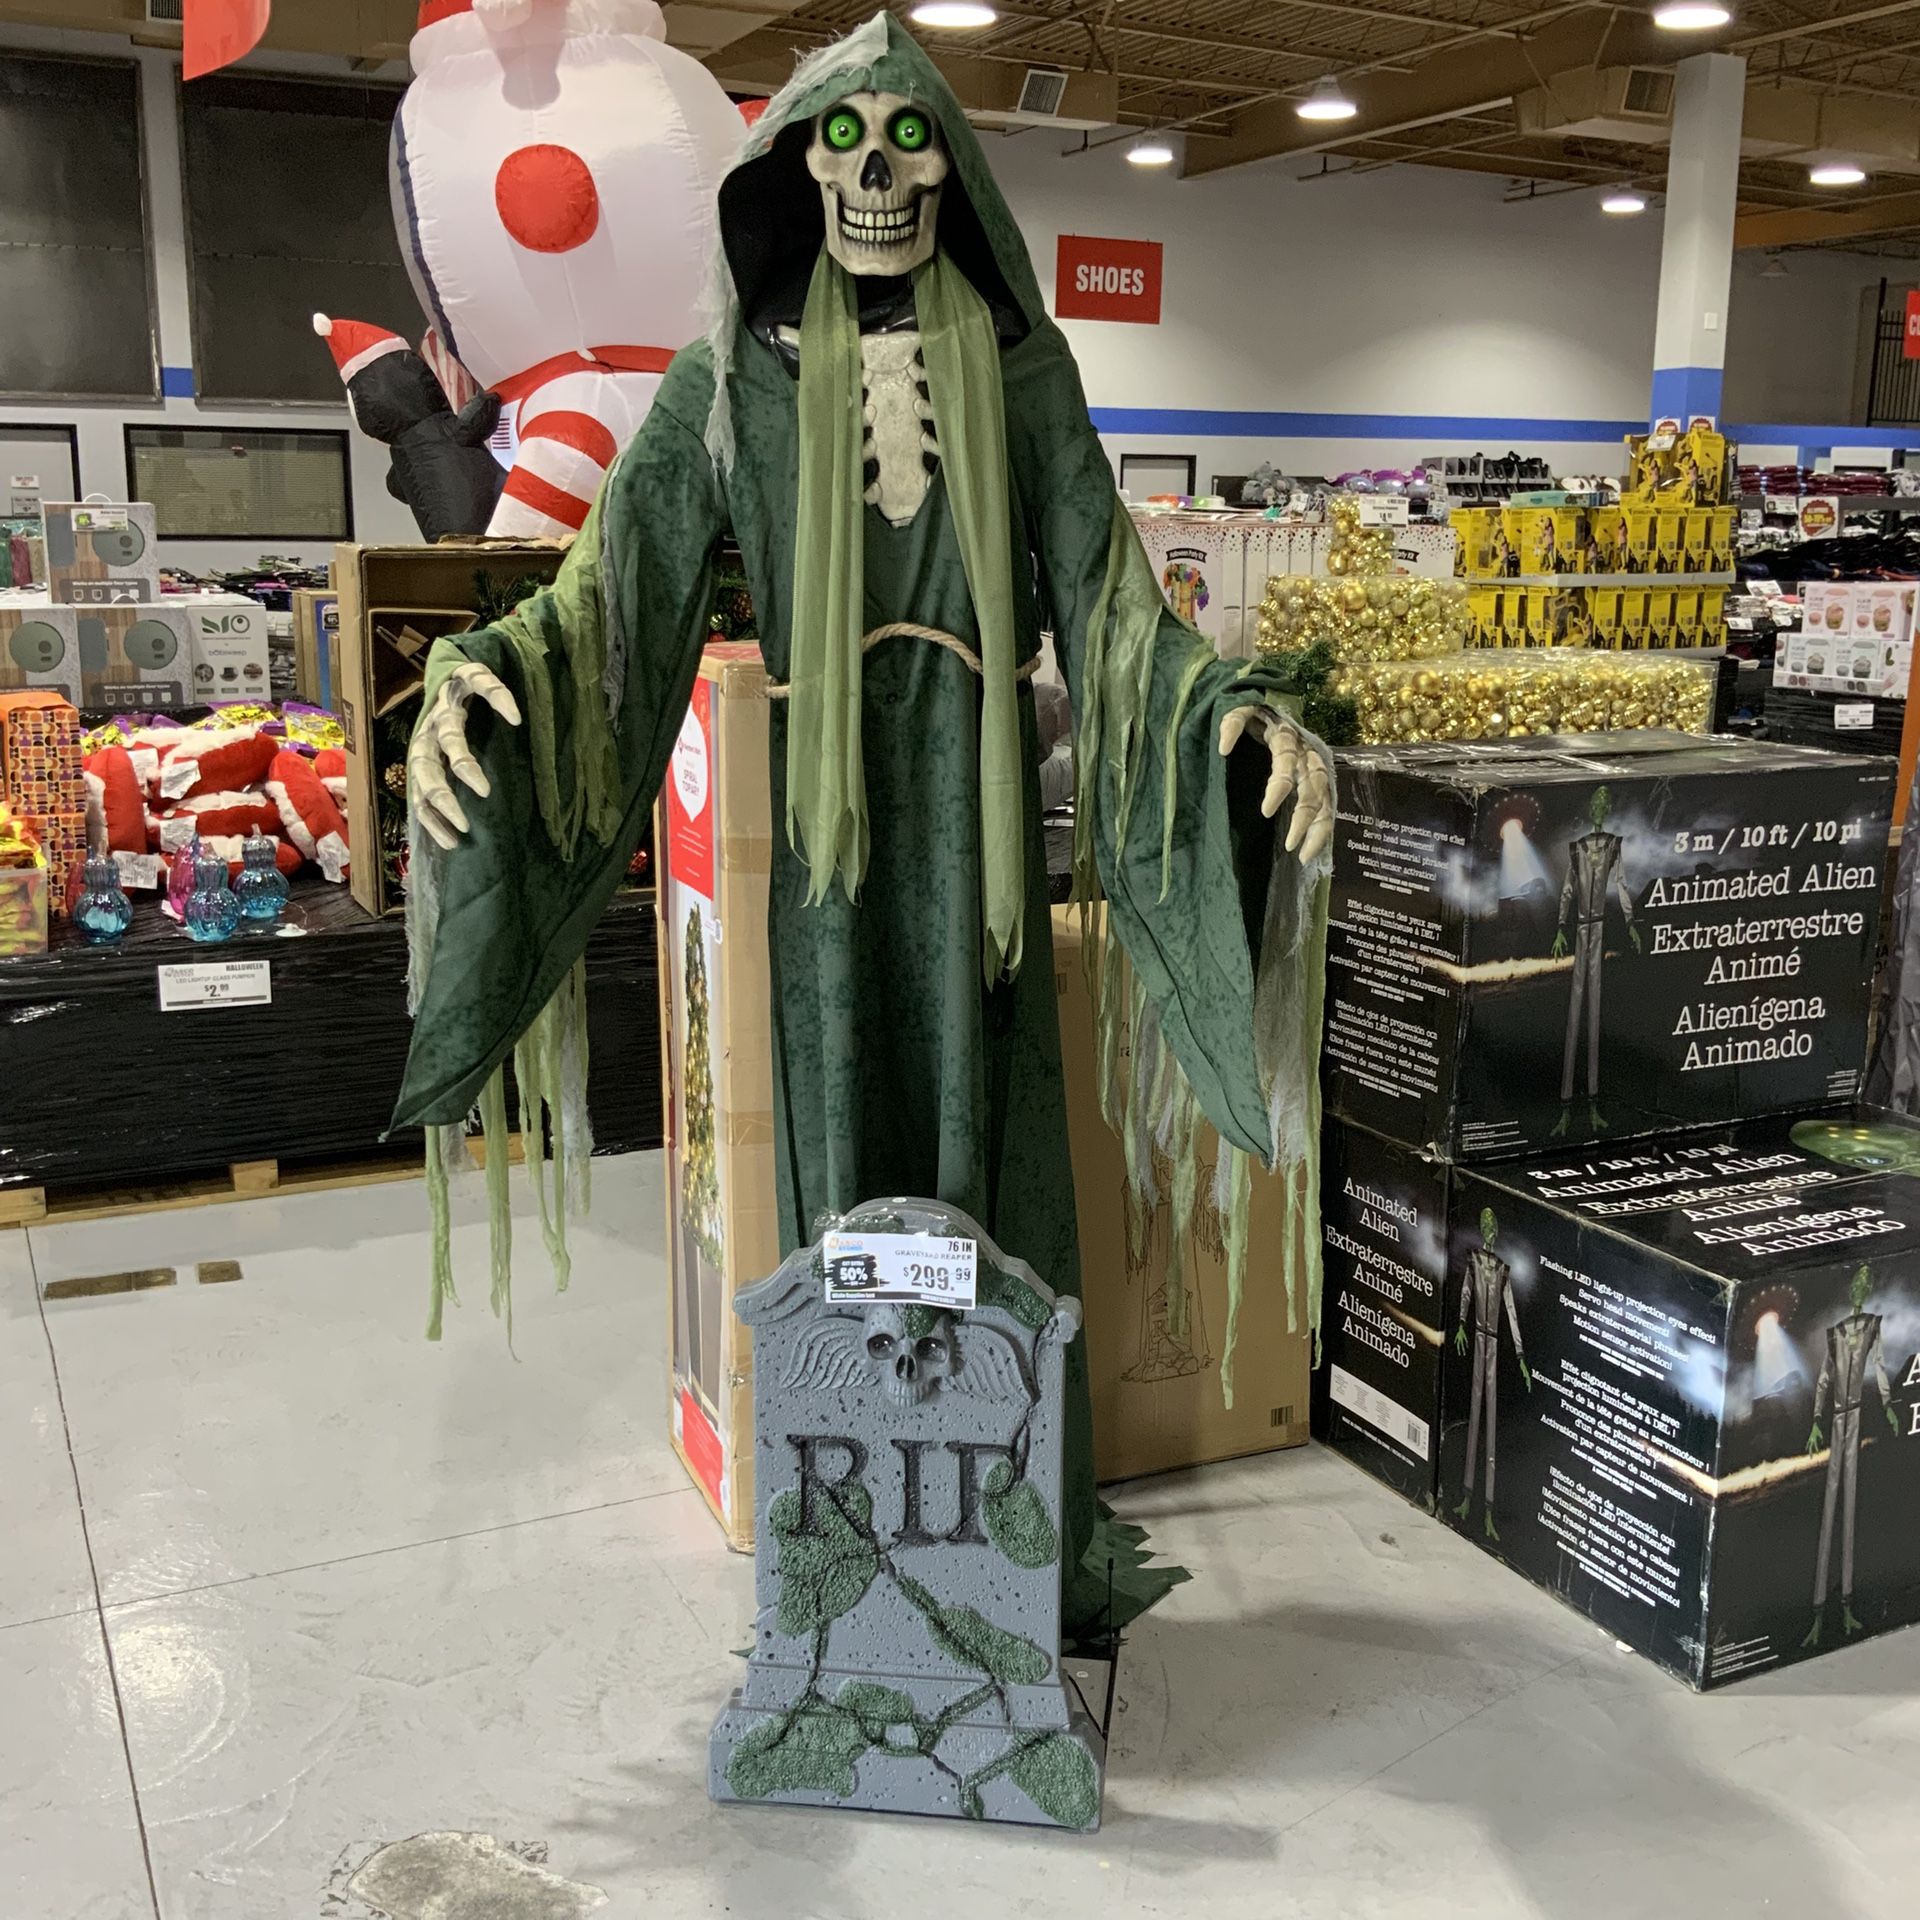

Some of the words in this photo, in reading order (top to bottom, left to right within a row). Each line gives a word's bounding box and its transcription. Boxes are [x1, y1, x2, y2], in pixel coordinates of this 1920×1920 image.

[1075, 264, 1145, 296] SHOES
[1674, 831, 1689, 854] 3
[1692, 832, 1714, 852] m
[1740, 825, 1765, 848] 10
[1768, 824, 1789, 846] ft
[1812, 820, 1837, 843] 10
[1839, 817, 1862, 844] pi
[1645, 866, 1790, 909] Animated
[1798, 862, 1876, 893] Alien
[1650, 908, 1864, 955] Extraterrestre
[1703, 946, 1801, 986] Animé
[1672, 995, 1826, 1036] Alienígena
[1680, 1029, 1813, 1072] Animado
[1527, 1170, 1552, 1180] 3
[1550, 1168, 1582, 1177] m
[1599, 1159, 1633, 1170] 10
[1631, 1156, 1660, 1166] ft
[1677, 1148, 1708, 1159] 10
[1708, 1144, 1739, 1156] pi
[1537, 1167, 1711, 1198] Animated
[1712, 1153, 1807, 1175] Alien
[1343, 1176, 1418, 1228] Animated
[1577, 1170, 1838, 1215] Extraterrestre
[1681, 1193, 1802, 1222] Animé
[948, 1241, 960, 1252] 76
[962, 1242, 972, 1252] IN
[1359, 1208, 1400, 1242] Alien
[1693, 1205, 1885, 1245] Alienígena
[1740, 1219, 1906, 1256] Animado
[840, 1267, 868, 1281] 50%
[940, 1252, 972, 1261] REAPER
[1325, 1224, 1433, 1297] Extraterrestre
[1353, 1263, 1403, 1304] Animé
[1540, 1255, 1573, 1280] Flashing
[1574, 1272, 1592, 1287] LED
[1626, 1296, 1666, 1322] projection
[1668, 1316, 1687, 1332] eyes
[1578, 1288, 1602, 1306] Servo
[1604, 1300, 1623, 1316] head
[1338, 1290, 1416, 1349] Alienígena
[1559, 1294, 1587, 1314] Speaks
[1589, 1308, 1652, 1345] extraterrestrial
[1342, 1316, 1410, 1368] Animado
[1573, 1315, 1600, 1335] Motion
[1601, 1331, 1628, 1349] sensor
[1630, 1344, 1673, 1371] activation!
[1560, 1359, 1579, 1376] Effet
[1581, 1370, 1620, 1397] clignotant
[1622, 1391, 1636, 1405] des
[1638, 1399, 1659, 1417] yeux
[1661, 1411, 1680, 1429] avec
[1562, 1372, 1601, 1399] projection
[1602, 1390, 1643, 1421] lumineuse
[1653, 1418, 1670, 1436] DEL
[1531, 1369, 1574, 1398] Mouvement
[1575, 1393, 1585, 1405] de
[1587, 1398, 1595, 1410] la
[1638, 1426, 1650, 1439] au
[1651, 1434, 1704, 1469] servomoteur
[1560, 1399, 1596, 1425] Prononce
[1597, 1419, 1611, 1434] des
[1613, 1427, 1646, 1452] phrases
[1540, 1413, 1582, 1441] Activation
[1580, 1436, 1595, 1451] par
[1595, 1445, 1627, 1468] capteur
[1628, 1462, 1638, 1475] de
[1640, 1471, 1688, 1503] mouvement
[1594, 1430, 1651, 1466] extraterrestre
[785, 1433, 1018, 1546] RIP
[1576, 1482, 1586, 1494] de
[1587, 1489, 1603, 1505] ojos
[1604, 1499, 1614, 1511] de
[1616, 1506, 1659, 1538] proyección
[1660, 1532, 1676, 1548] con
[1598, 1506, 1616, 1523] LED
[1562, 1513, 1586, 1535] frases
[1588, 1529, 1610, 1549] fuera
[1610, 1544, 1626, 1559] con
[1626, 1555, 1644, 1571] este
[1579, 1540, 1589, 1551] de
[1590, 1548, 1617, 1568] sensor
[1618, 1564, 1628, 1576] de
[1627, 1539, 1638, 1551] de
[1639, 1545, 1648, 1558] la
